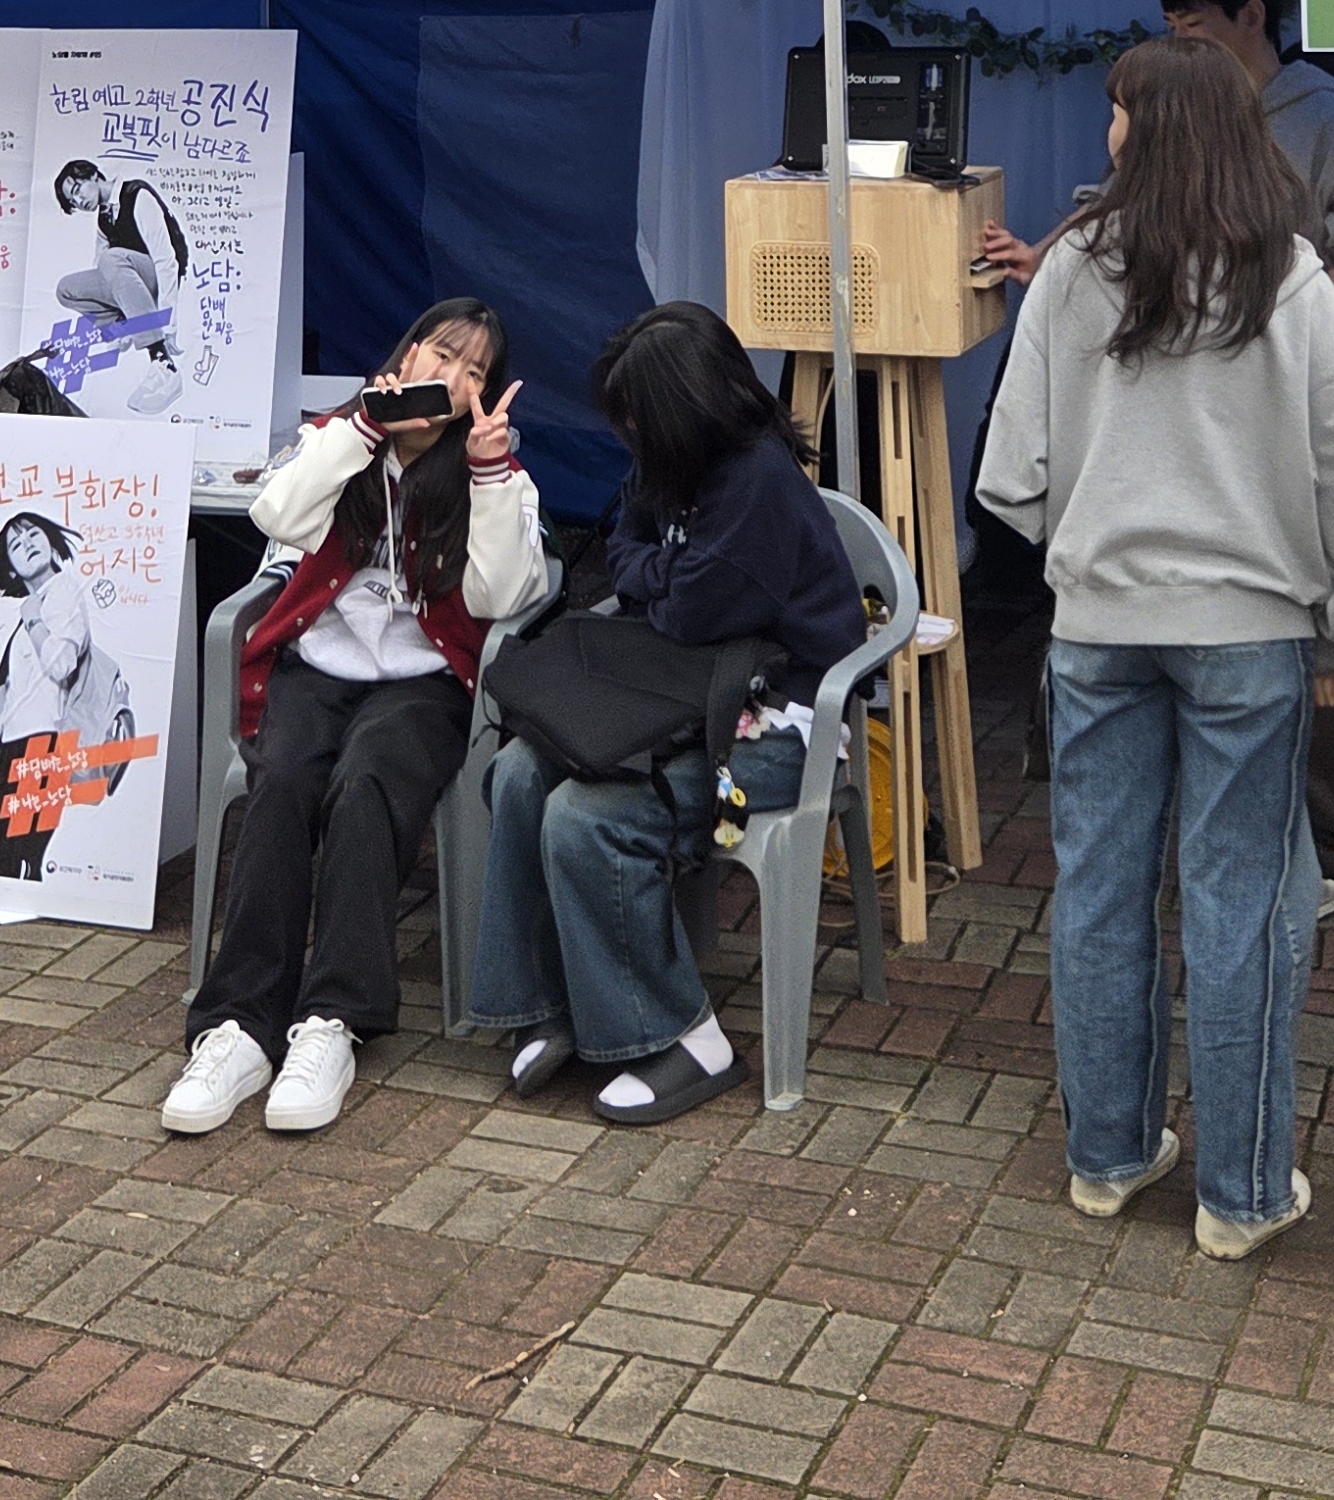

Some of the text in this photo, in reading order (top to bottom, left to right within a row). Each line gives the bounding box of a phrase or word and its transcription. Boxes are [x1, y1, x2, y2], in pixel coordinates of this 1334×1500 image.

[135, 87, 179, 112] 2학년
[180, 79, 270, 133] 공진식
[200, 296, 226, 320] 담배
